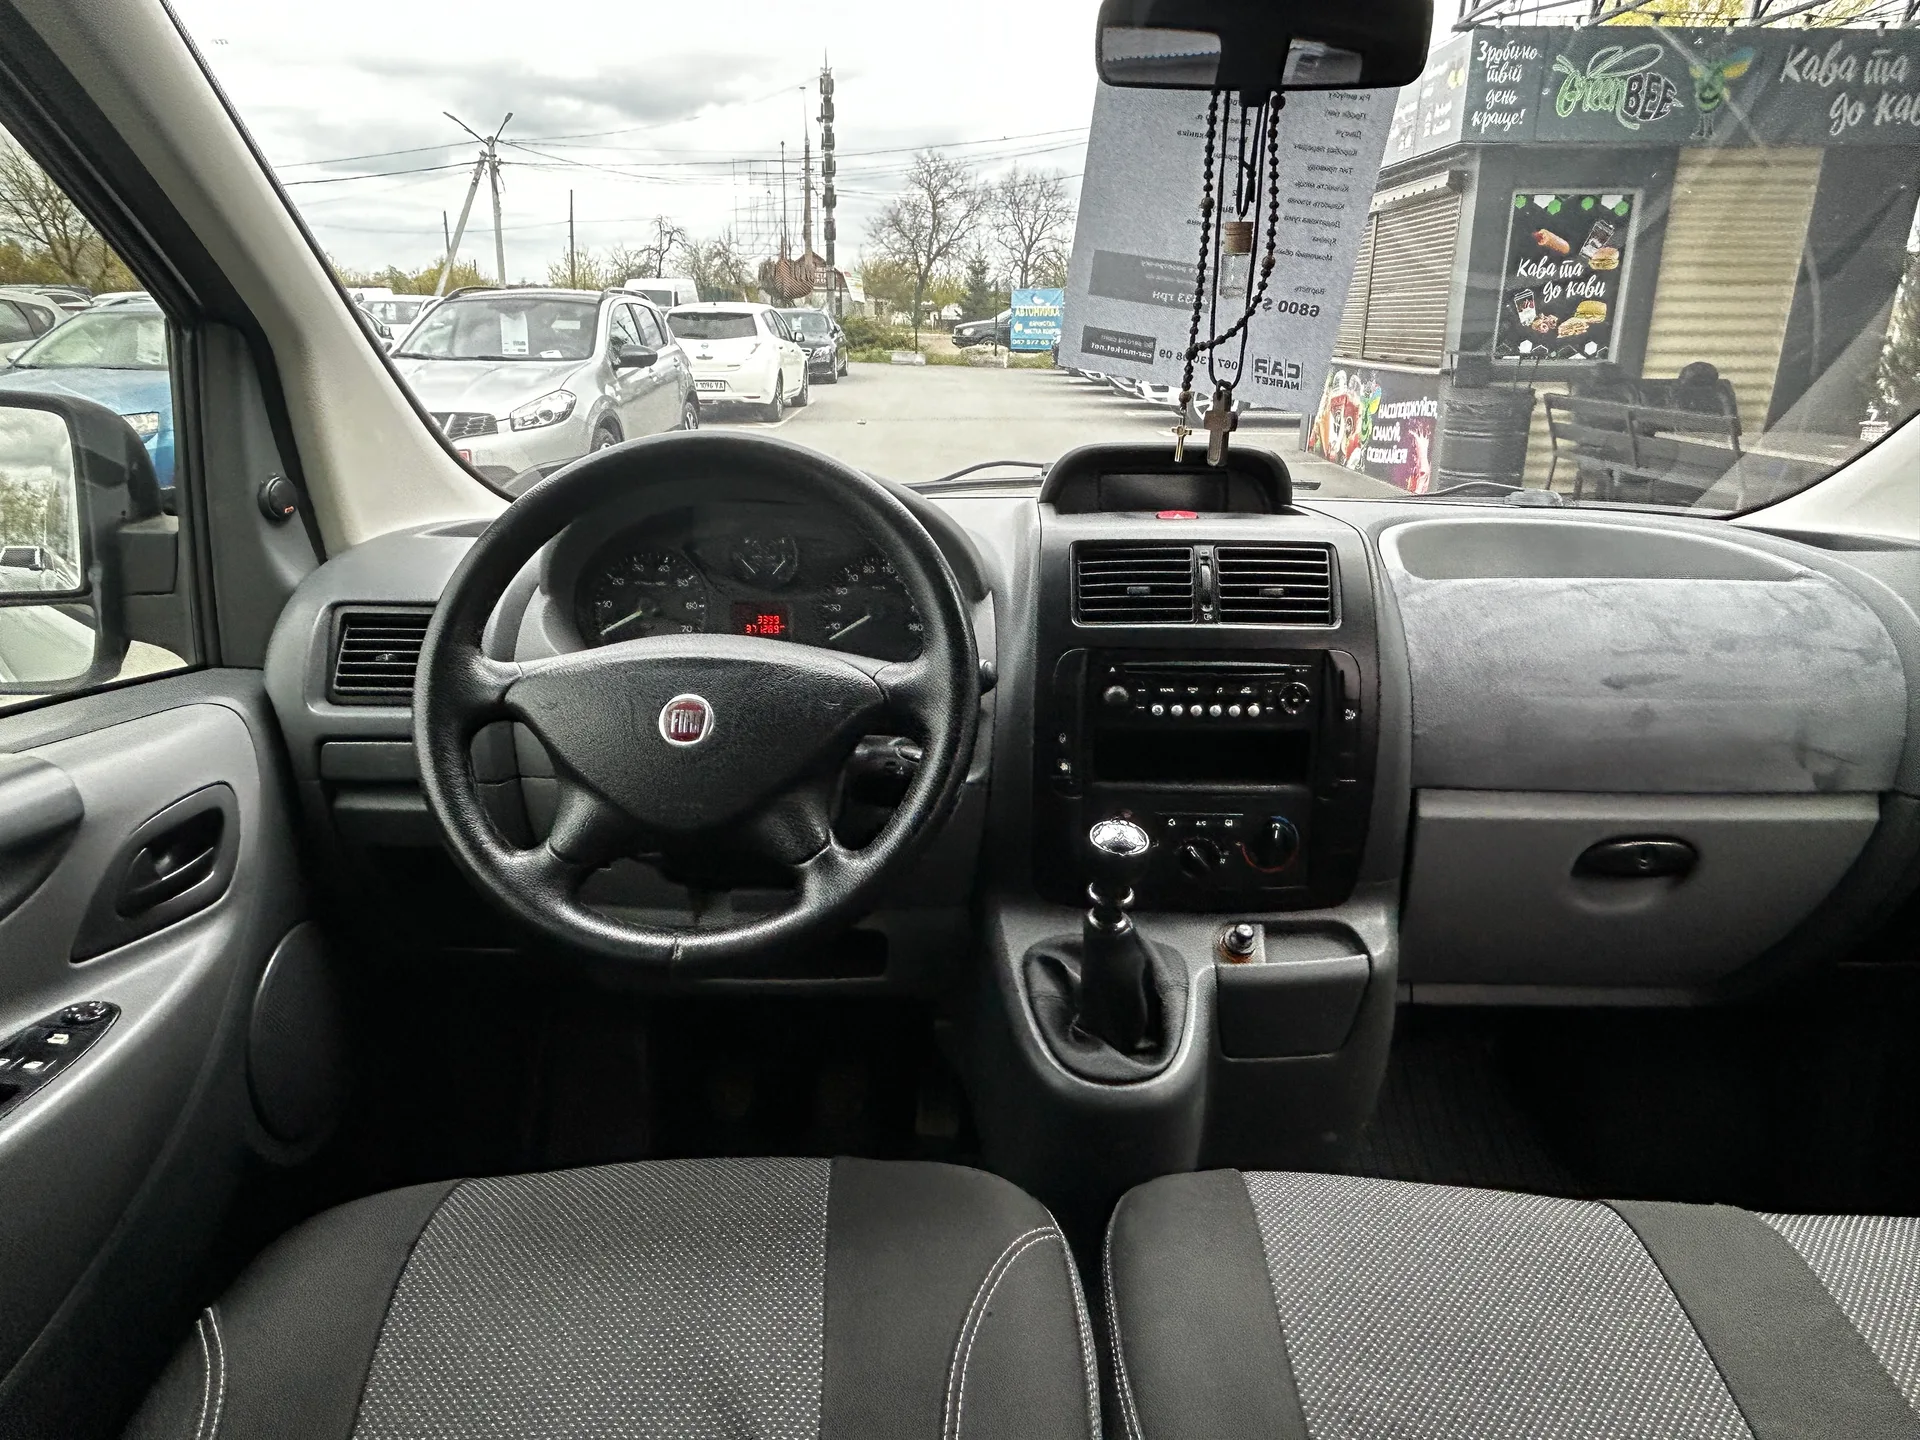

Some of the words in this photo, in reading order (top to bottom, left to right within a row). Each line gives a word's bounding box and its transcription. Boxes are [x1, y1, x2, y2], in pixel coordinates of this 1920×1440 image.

[1477, 40, 1538, 66] Зробимо
[1779, 39, 1857, 87] Кава
[1863, 49, 1909, 85] та
[1486, 63, 1522, 84] твій
[1485, 88, 1518, 109] день
[1471, 108, 1526, 134] краще!
[1829, 92, 1866, 136] до
[1517, 255, 1557, 279] Кава
[1559, 260, 1584, 278] та
[1543, 280, 1562, 303] до
[1565, 275, 1606, 298] кави
[681, 625, 693, 633] 70
